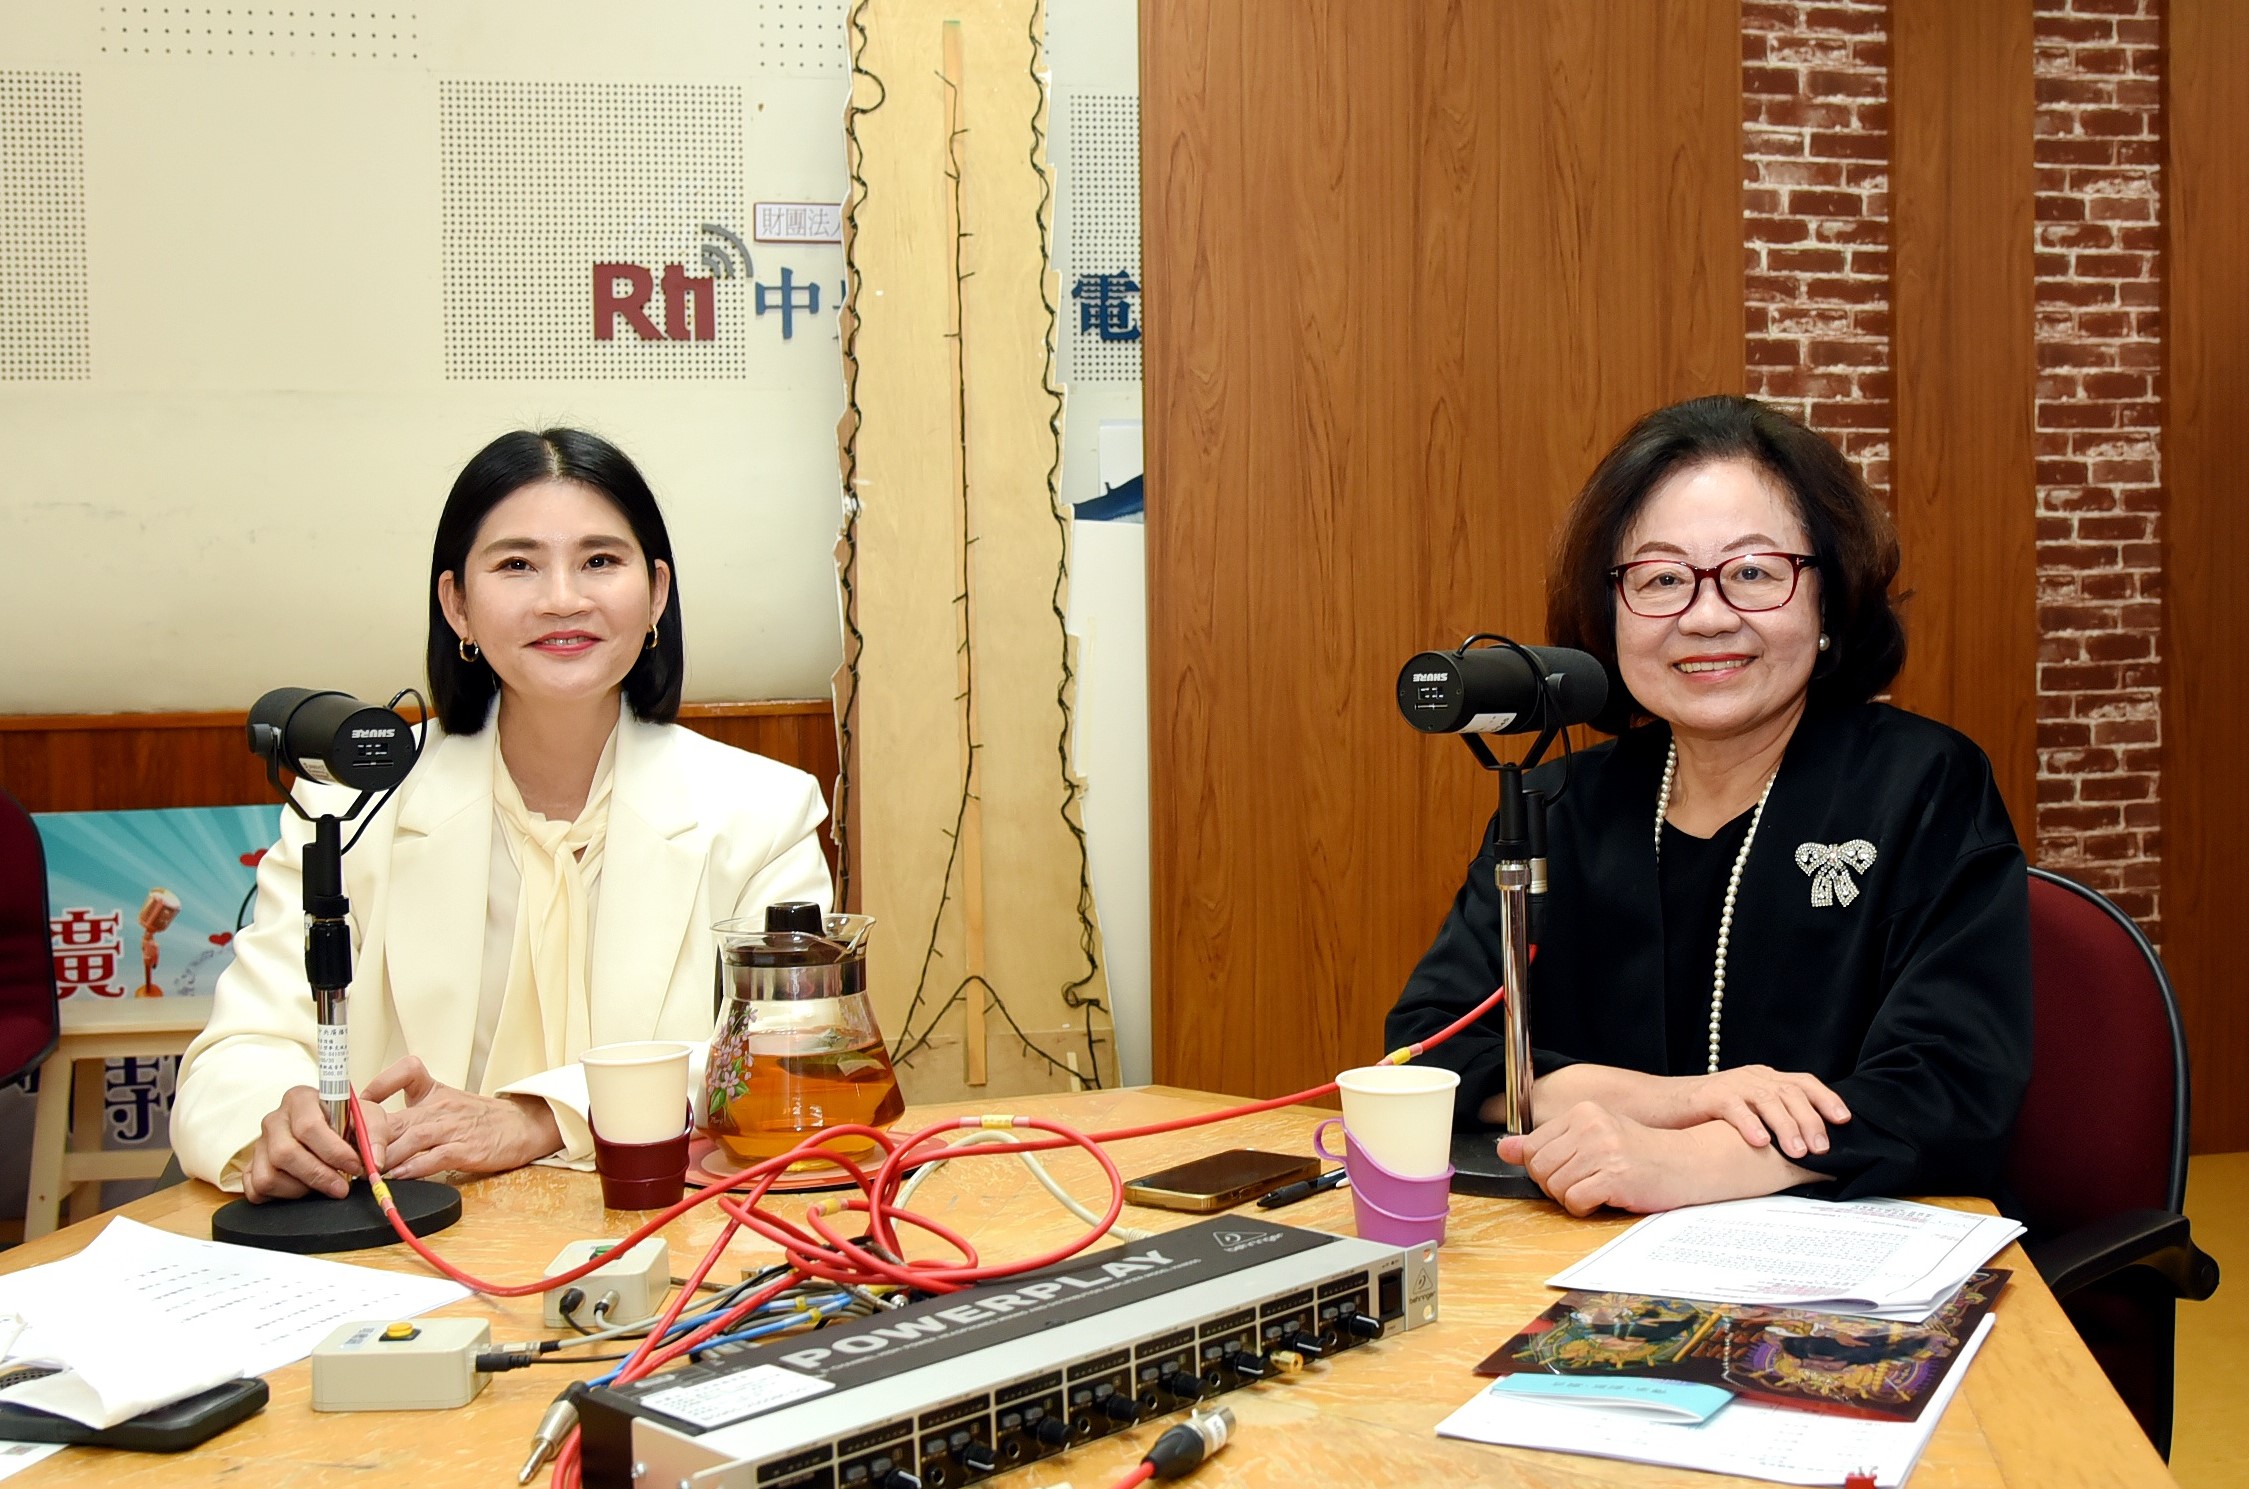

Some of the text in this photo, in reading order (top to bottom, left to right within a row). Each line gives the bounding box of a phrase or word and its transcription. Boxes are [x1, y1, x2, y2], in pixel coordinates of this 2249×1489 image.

[755, 266, 847, 340] 中
[1071, 269, 1142, 342] 電
[1412, 672, 1449, 682] SHURE
[351, 728, 396, 739] SHURE
[779, 1249, 1174, 1369] POWERPLAY
